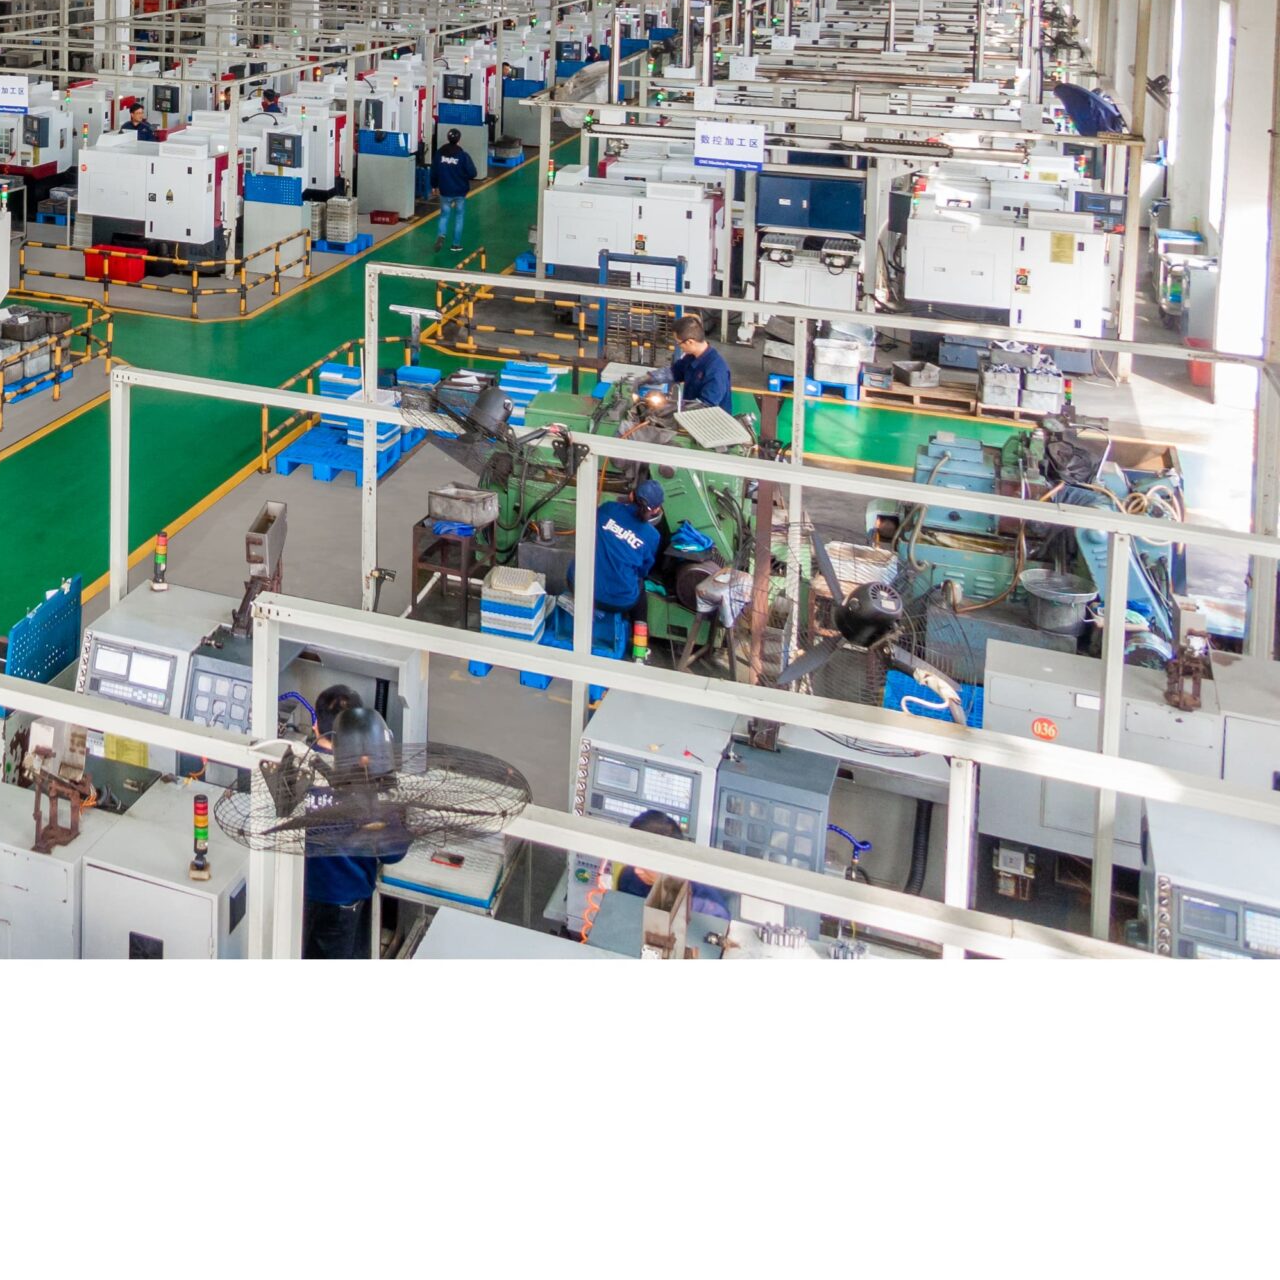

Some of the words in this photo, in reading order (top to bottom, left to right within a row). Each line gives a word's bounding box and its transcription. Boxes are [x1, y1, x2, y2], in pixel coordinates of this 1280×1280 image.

[700, 135, 759, 149] 数控加工区
[1033, 720, 1057, 738] 036
